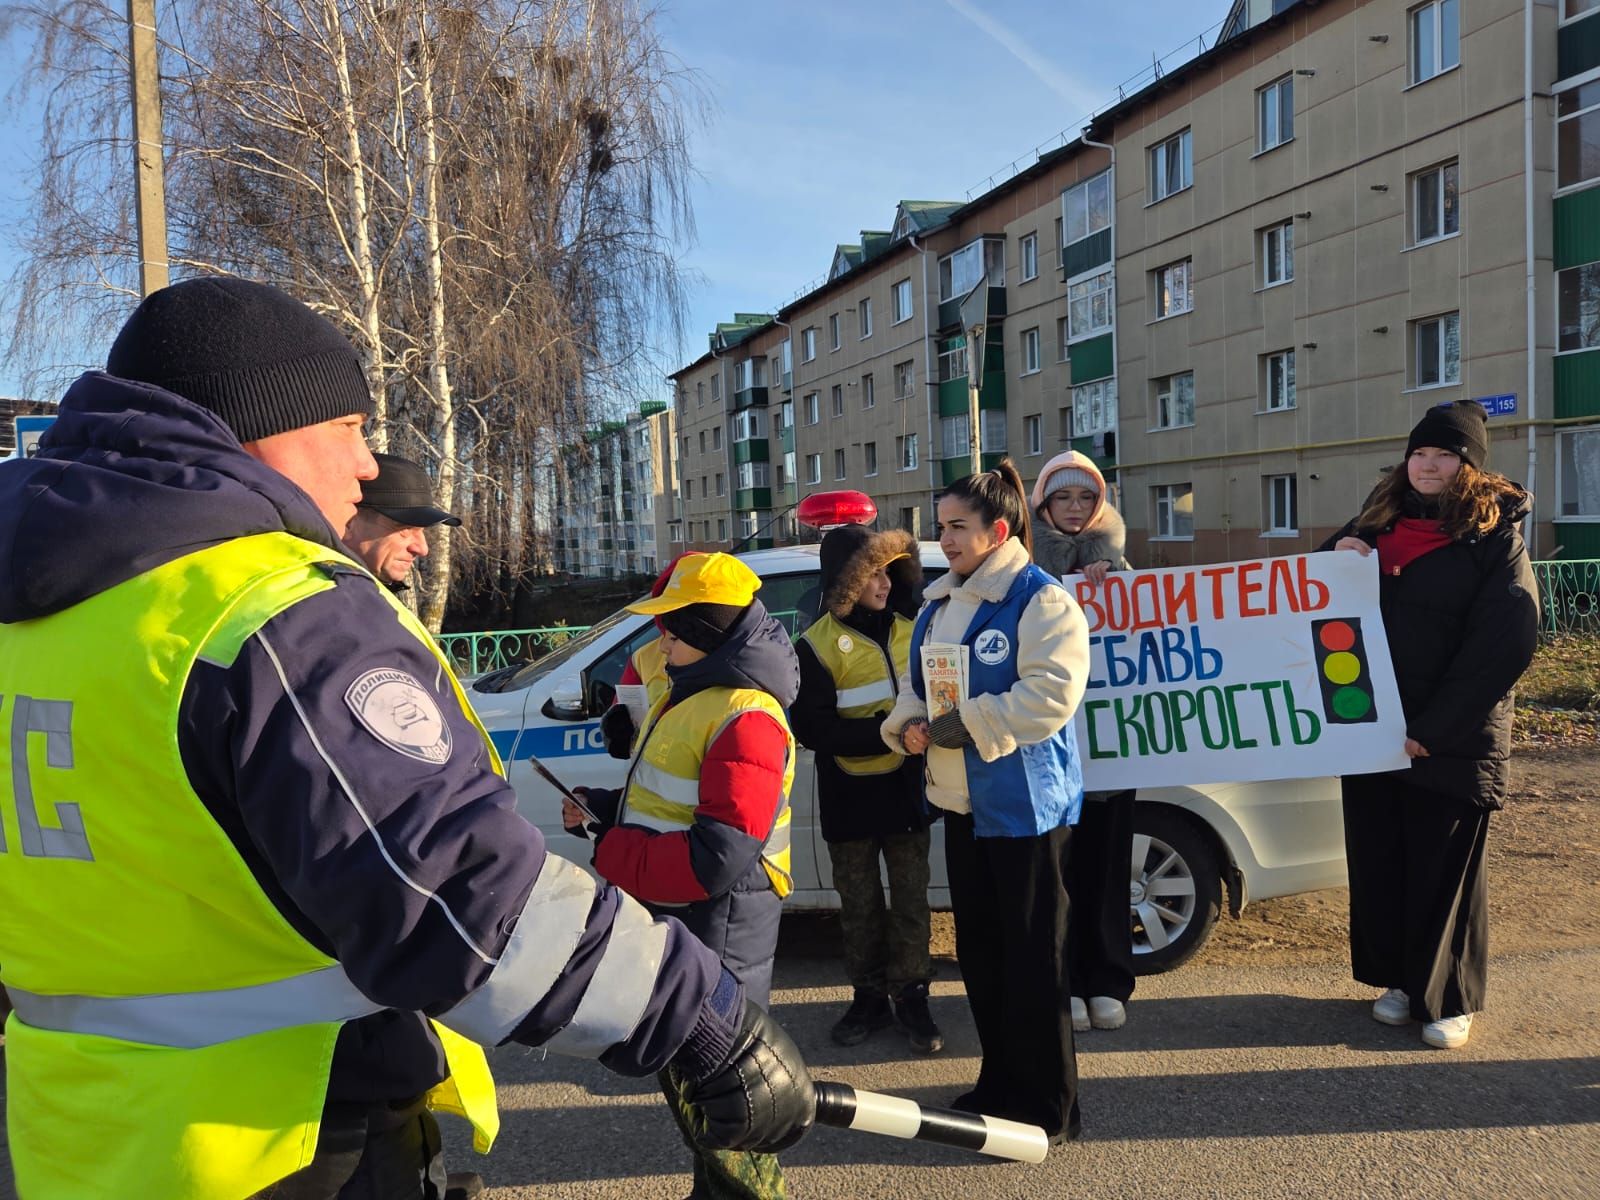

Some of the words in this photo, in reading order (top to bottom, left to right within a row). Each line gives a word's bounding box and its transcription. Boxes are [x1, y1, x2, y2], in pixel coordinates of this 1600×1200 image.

[1498, 399, 1515, 410] 155
[1076, 557, 1330, 634] ВОДИТЕЛЬ
[353, 671, 416, 707] ПОЛИЦИЯ
[1084, 680, 1321, 760] СКОРОСТЬ
